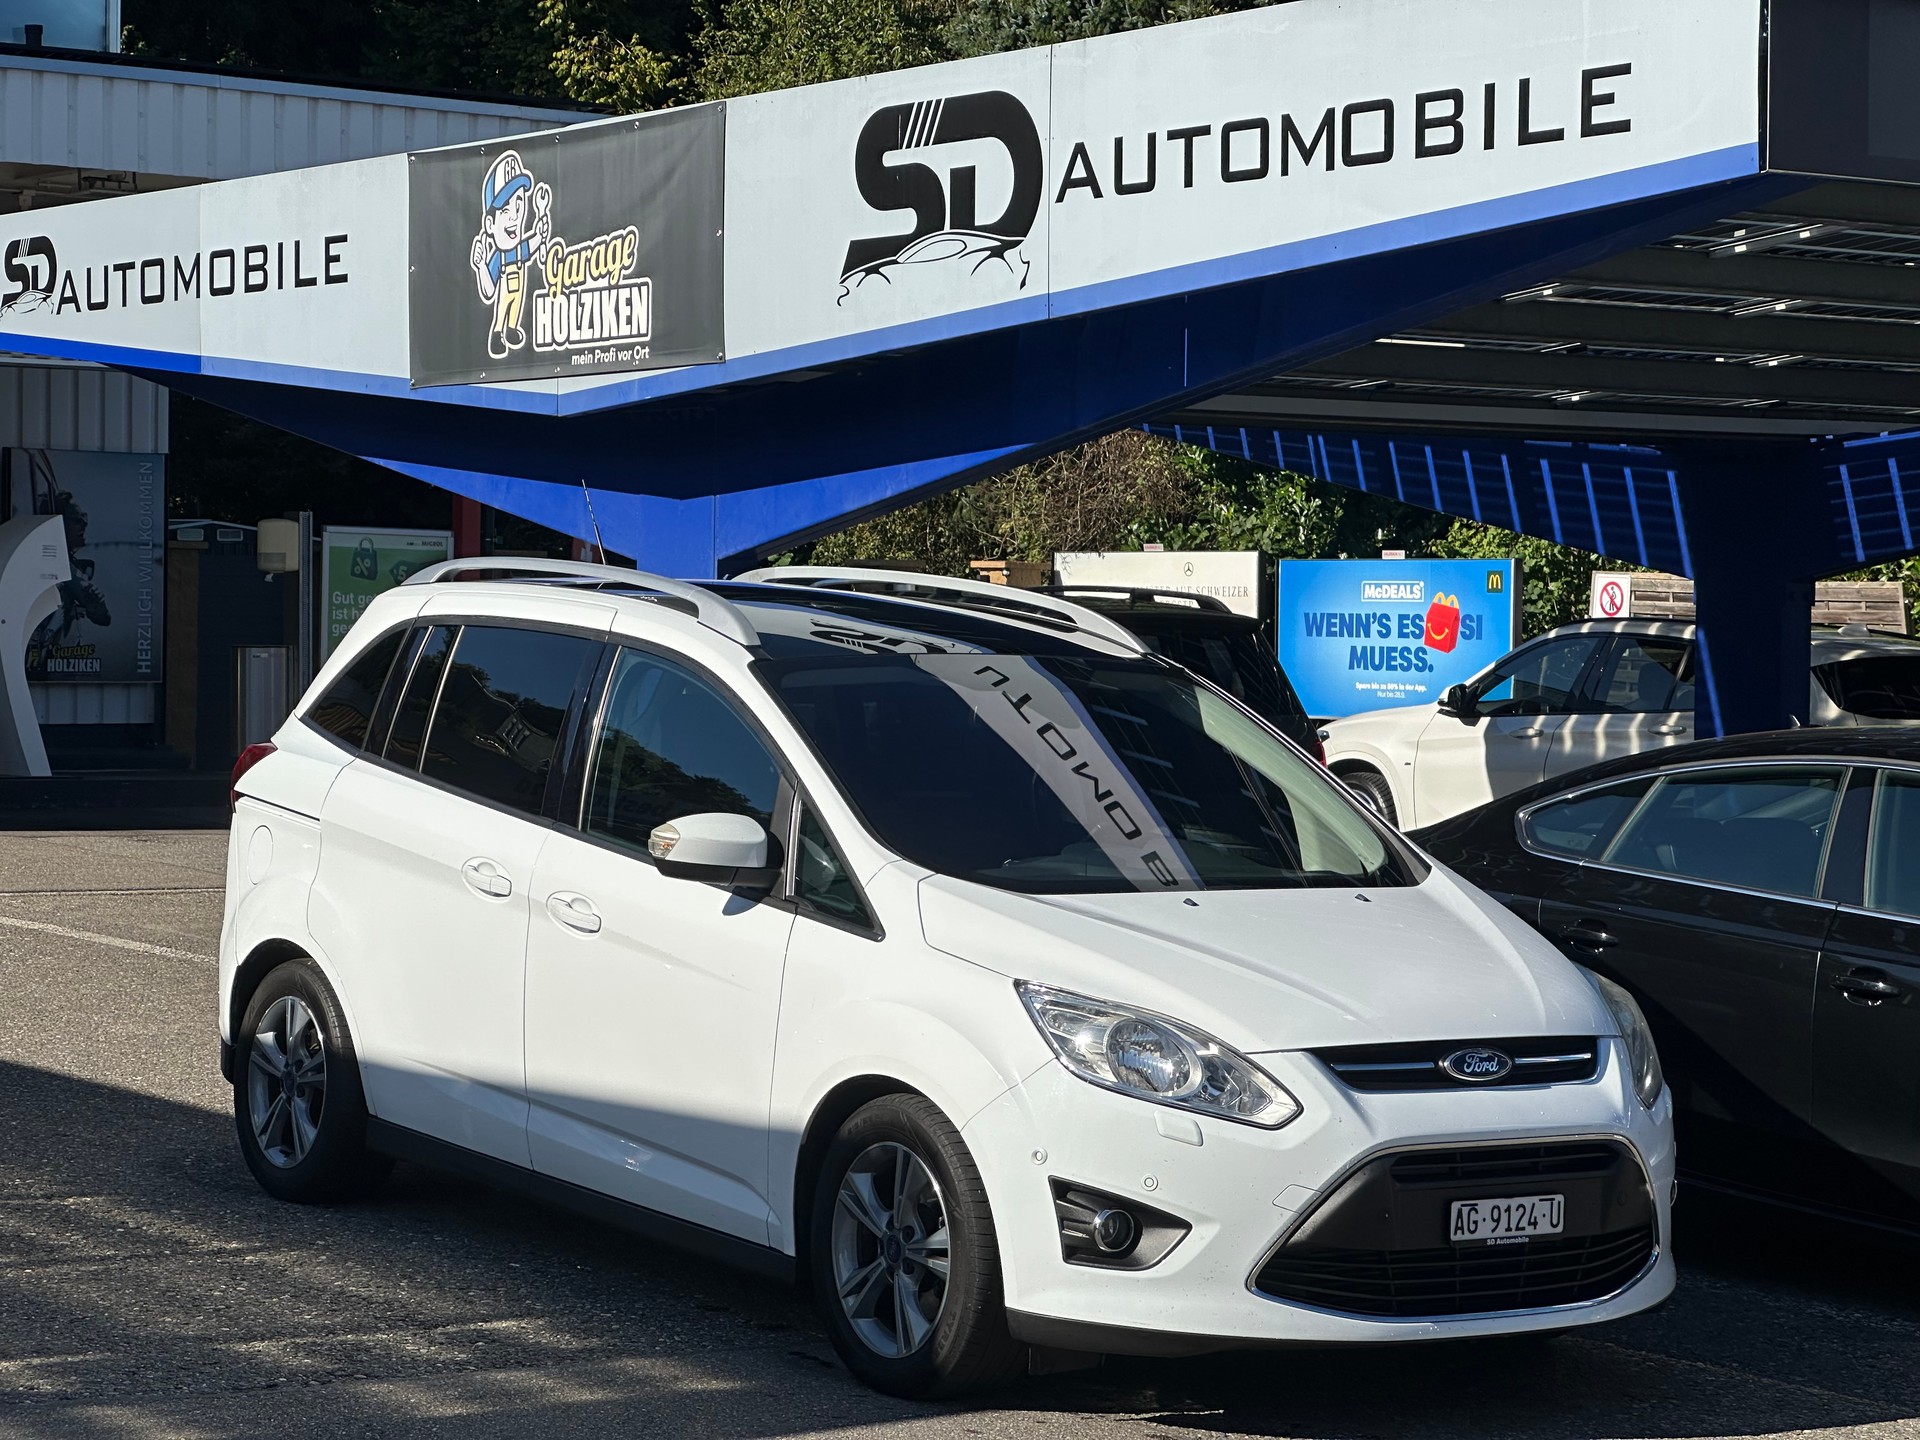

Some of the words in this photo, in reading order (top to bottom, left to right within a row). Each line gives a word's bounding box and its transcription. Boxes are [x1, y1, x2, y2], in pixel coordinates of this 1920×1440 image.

[841, 90, 1043, 280] SD
[1055, 63, 1632, 203] AUTOMOBILE
[1, 235, 57, 309] SD
[56, 234, 348, 315] AUTOMOBILE
[545, 230, 637, 299] Garage
[536, 285, 649, 344] HOLZIKEN
[571, 350, 593, 365] mein
[594, 347, 616, 363] Profi
[617, 350, 632, 361] vor
[633, 345, 649, 360] Ort
[138, 462, 153, 583] WILLKOMMEN
[332, 591, 354, 605] Gut
[358, 593, 376, 608] ge
[1196, 586, 1249, 598] SCHWEIZER
[1363, 584, 1422, 599] McDEALS
[332, 607, 348, 620] ist
[137, 588, 152, 673] HERZLICH
[52, 644, 96, 658] Garage
[1348, 645, 1434, 673] MUESS.
[47, 659, 100, 672] HOLZIKEN
[1463, 1053, 1499, 1073] Ford
[1496, 1236, 1530, 1245] Automobile
